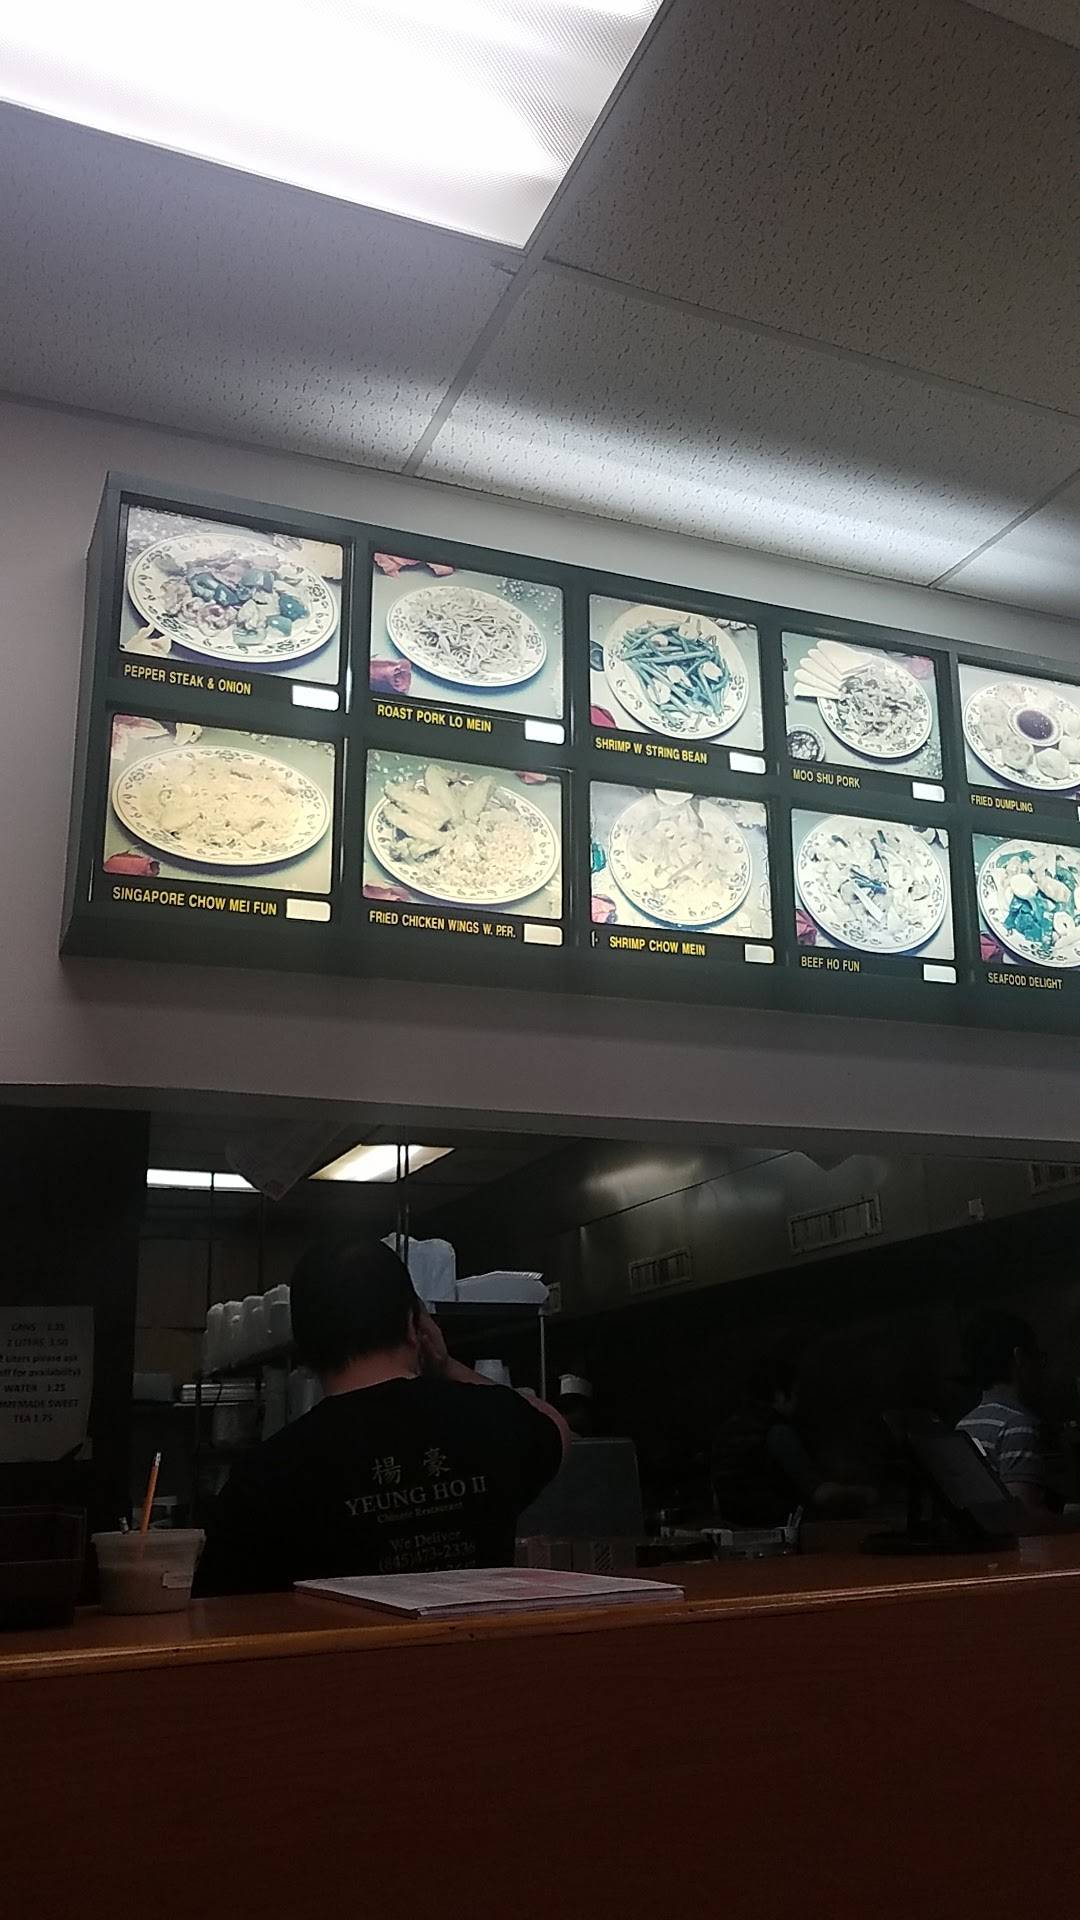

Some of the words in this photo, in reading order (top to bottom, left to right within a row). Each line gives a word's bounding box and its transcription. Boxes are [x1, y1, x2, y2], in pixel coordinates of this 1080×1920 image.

[123, 663, 166, 683] PEPPER
[168, 671, 204, 688] STEAK
[206, 677, 215, 690] &
[217, 678, 251, 696] ONION
[377, 704, 414, 721] ROAST
[416, 710, 447, 726] PORK
[448, 716, 463, 729] LO
[466, 717, 492, 733] MEIN
[594, 736, 632, 753] SHRIMP
[632, 743, 643, 755] W
[645, 744, 681, 761] STRING
[681, 749, 708, 764] BEAN
[792, 768, 814, 782] MOO
[816, 772, 834, 785] SHU
[836, 774, 861, 789] PORK
[970, 794, 993, 807] FRIED
[995, 797, 1034, 813] DUMPLING
[111, 886, 186, 907] SINGAPORE
[188, 894, 227, 911] CHOW
[229, 899, 250, 913] MEI
[252, 901, 277, 916] FUN
[368, 910, 399, 925] FRIED
[401, 914, 445, 931] CHICKEN
[447, 919, 480, 934] WINGS
[609, 935, 646, 951] SHRIMP
[648, 940, 679, 954] CHOW
[681, 942, 706, 957] MEIN
[800, 955, 824, 969] BEEF
[826, 958, 840, 971] HO
[842, 959, 861, 973] FUN
[987, 971, 1027, 987] SEAFOOD
[1028, 975, 1063, 990] DELIGHT
[344, 1486, 427, 1516] YEUNG
[432, 1479, 466, 1500] HO
[413, 1530, 462, 1548] Deliver
